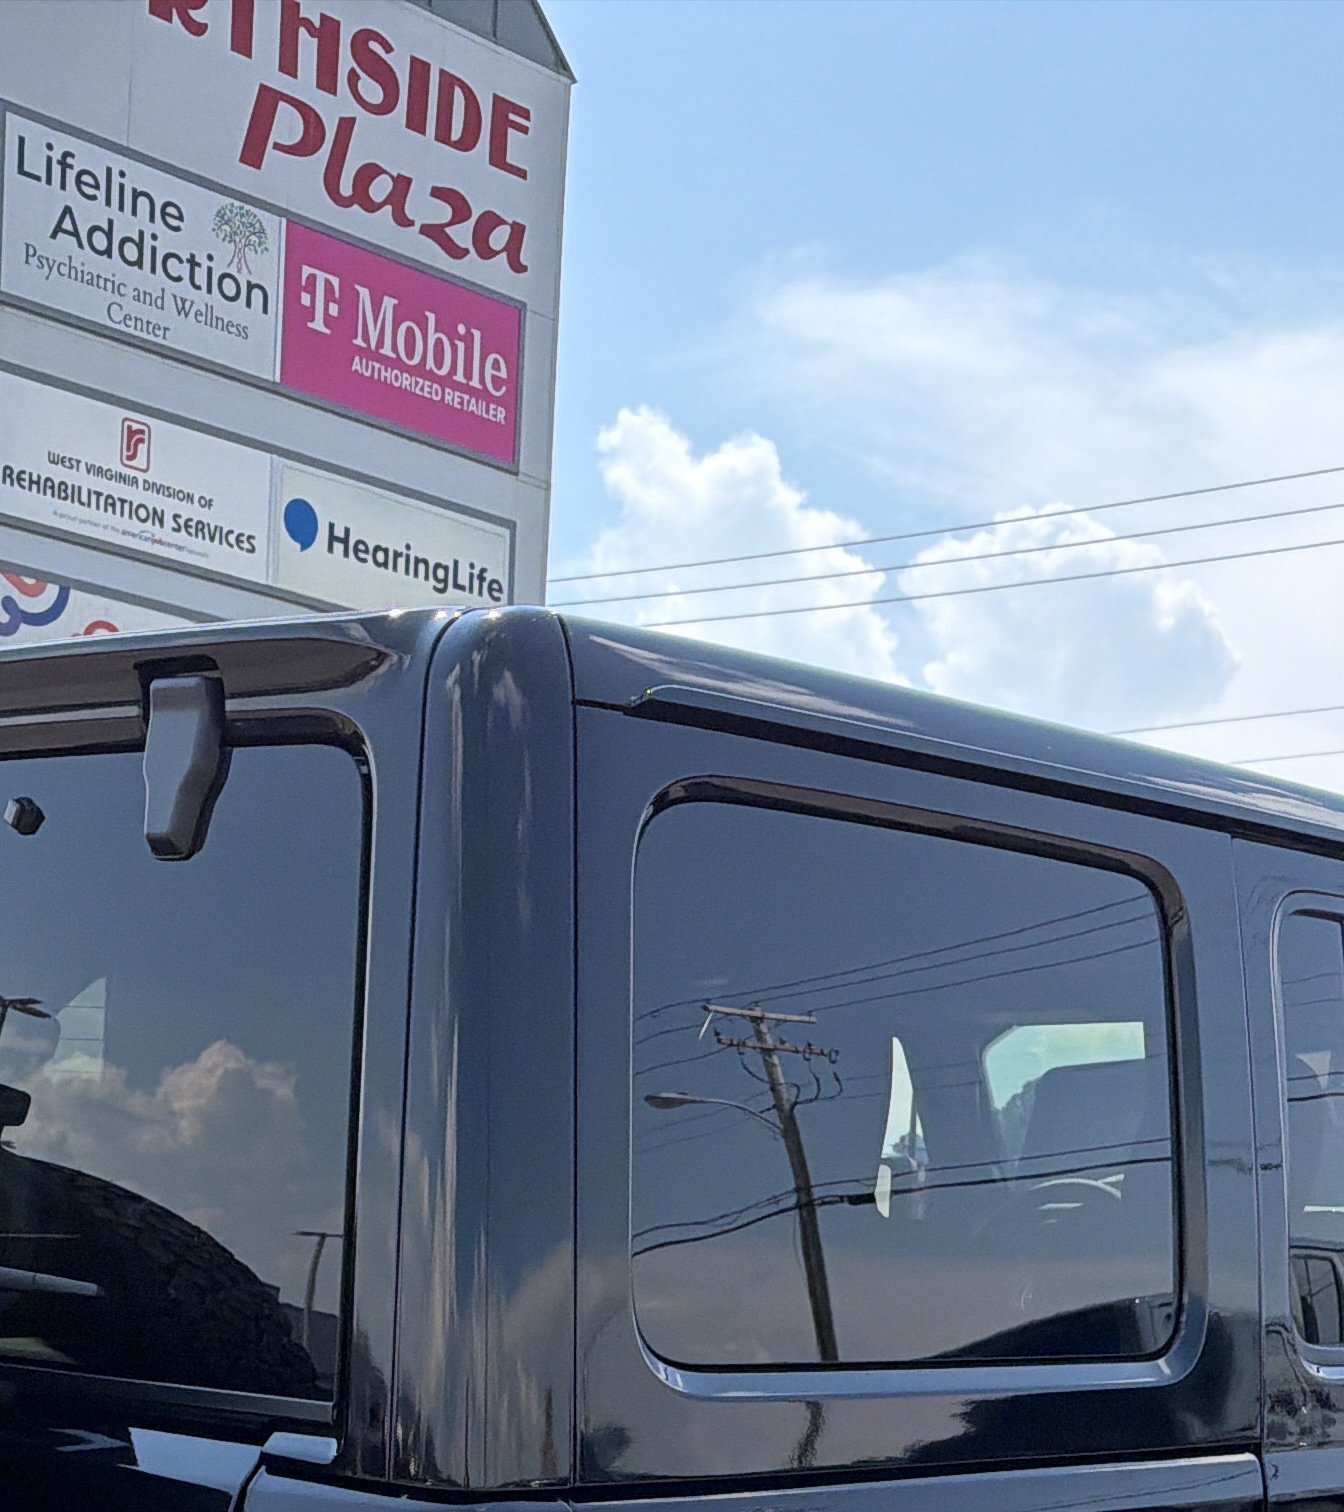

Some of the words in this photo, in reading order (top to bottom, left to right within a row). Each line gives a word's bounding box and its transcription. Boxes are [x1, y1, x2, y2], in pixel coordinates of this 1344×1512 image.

[17, 134, 185, 232] Lifeline
[239, 83, 529, 274] Plaza
[24, 242, 127, 297] Psychiatric
[132, 287, 166, 311] and
[171, 293, 250, 341] Wellness
[49, 204, 269, 315] Addiction
[107, 301, 171, 341] Center
[352, 284, 508, 397] Mobile
[351, 355, 442, 401] AUTHORIZED
[444, 387, 506, 425] RETAILER
[1, 464, 165, 529] REHABILITATION
[171, 513, 257, 555] SERVICES
[47, 450, 82, 473] WEST
[84, 461, 139, 490] VIRGINIA
[142, 478, 194, 505] DIVISION
[197, 494, 215, 511] OF
[327, 521, 504, 603] HearingLife
